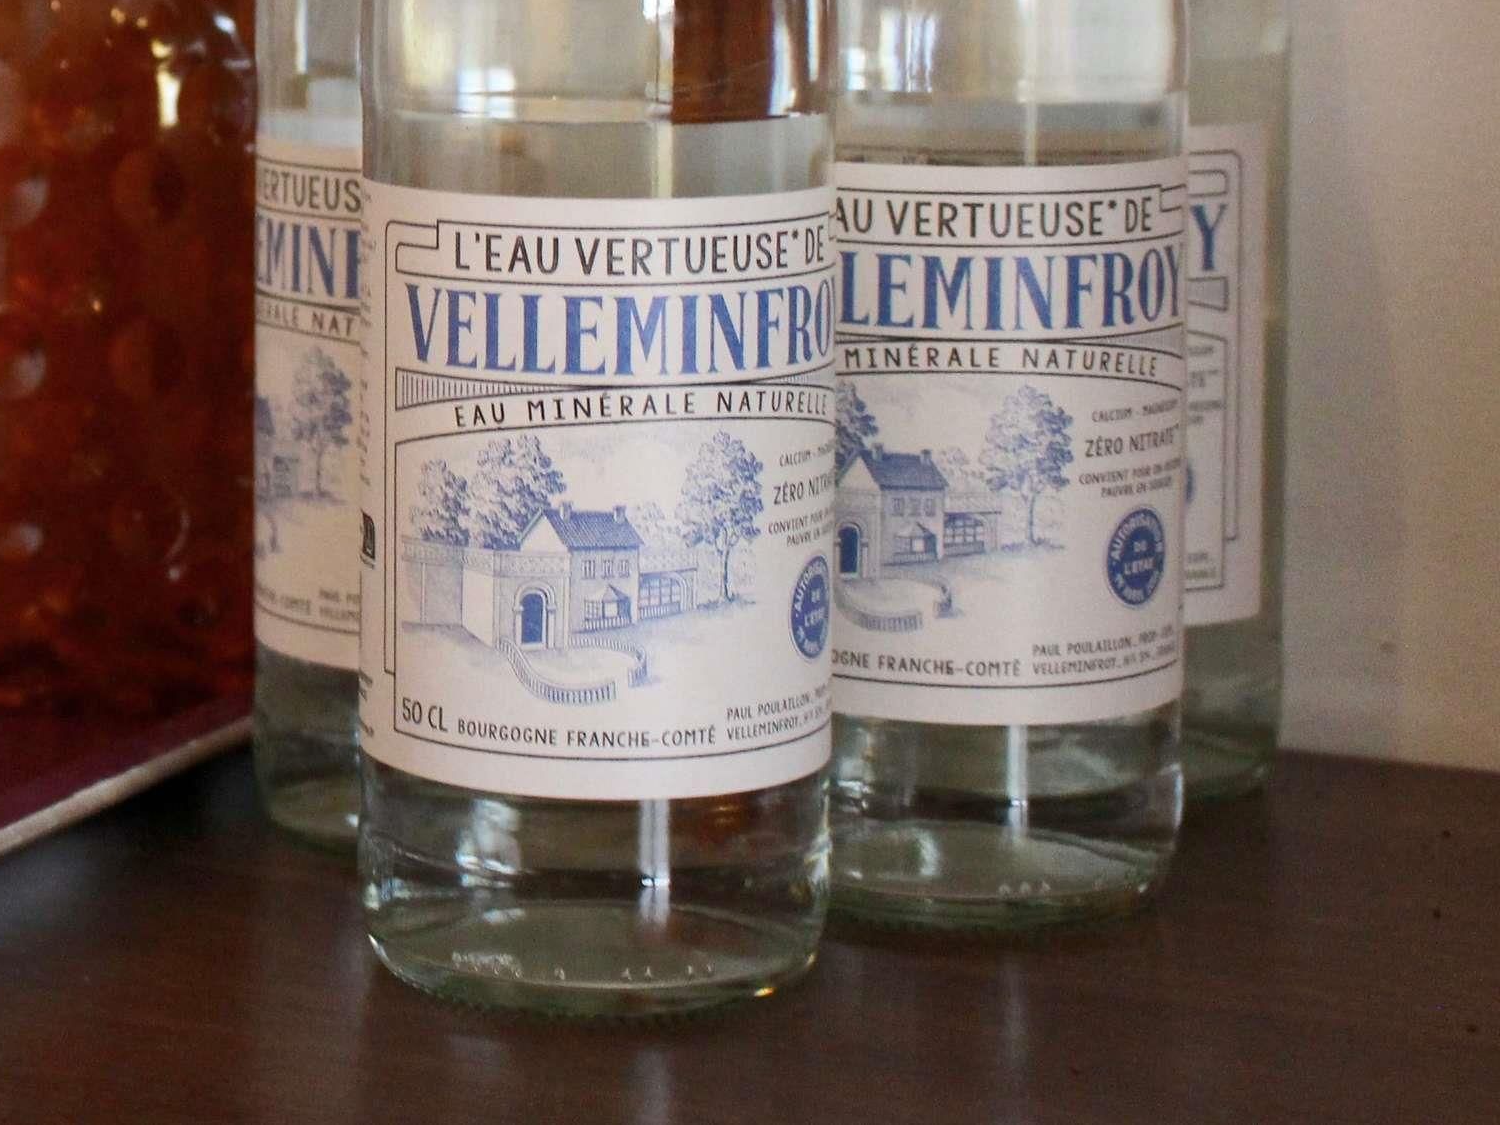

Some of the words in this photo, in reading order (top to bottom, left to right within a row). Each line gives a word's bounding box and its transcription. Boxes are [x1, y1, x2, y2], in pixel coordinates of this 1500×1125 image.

[1125, 196, 1153, 234] DE
[455, 231, 559, 275] L'EAU
[804, 225, 825, 266] DE
[405, 278, 836, 377] VELLEMINFRO
[844, 343, 1001, 369] MINÉRALE
[1022, 348, 1157, 377] NATURELLE
[454, 403, 506, 428] EAU
[527, 392, 698, 422] MINÉRALE
[717, 390, 827, 416] NATURELLE
[1084, 435, 1124, 458] ZÉRO
[773, 481, 804, 506] ZÉRO
[878, 653, 1021, 677] FRANCHE-COMTÉ
[1032, 642, 1061, 657] PAUL
[402, 697, 423, 725] 50
[427, 704, 448, 733] CL
[726, 705, 753, 722] PAUL
[457, 718, 557, 746] BOURGOGNE
[566, 725, 716, 748] FRANCHE-COMTÉ
